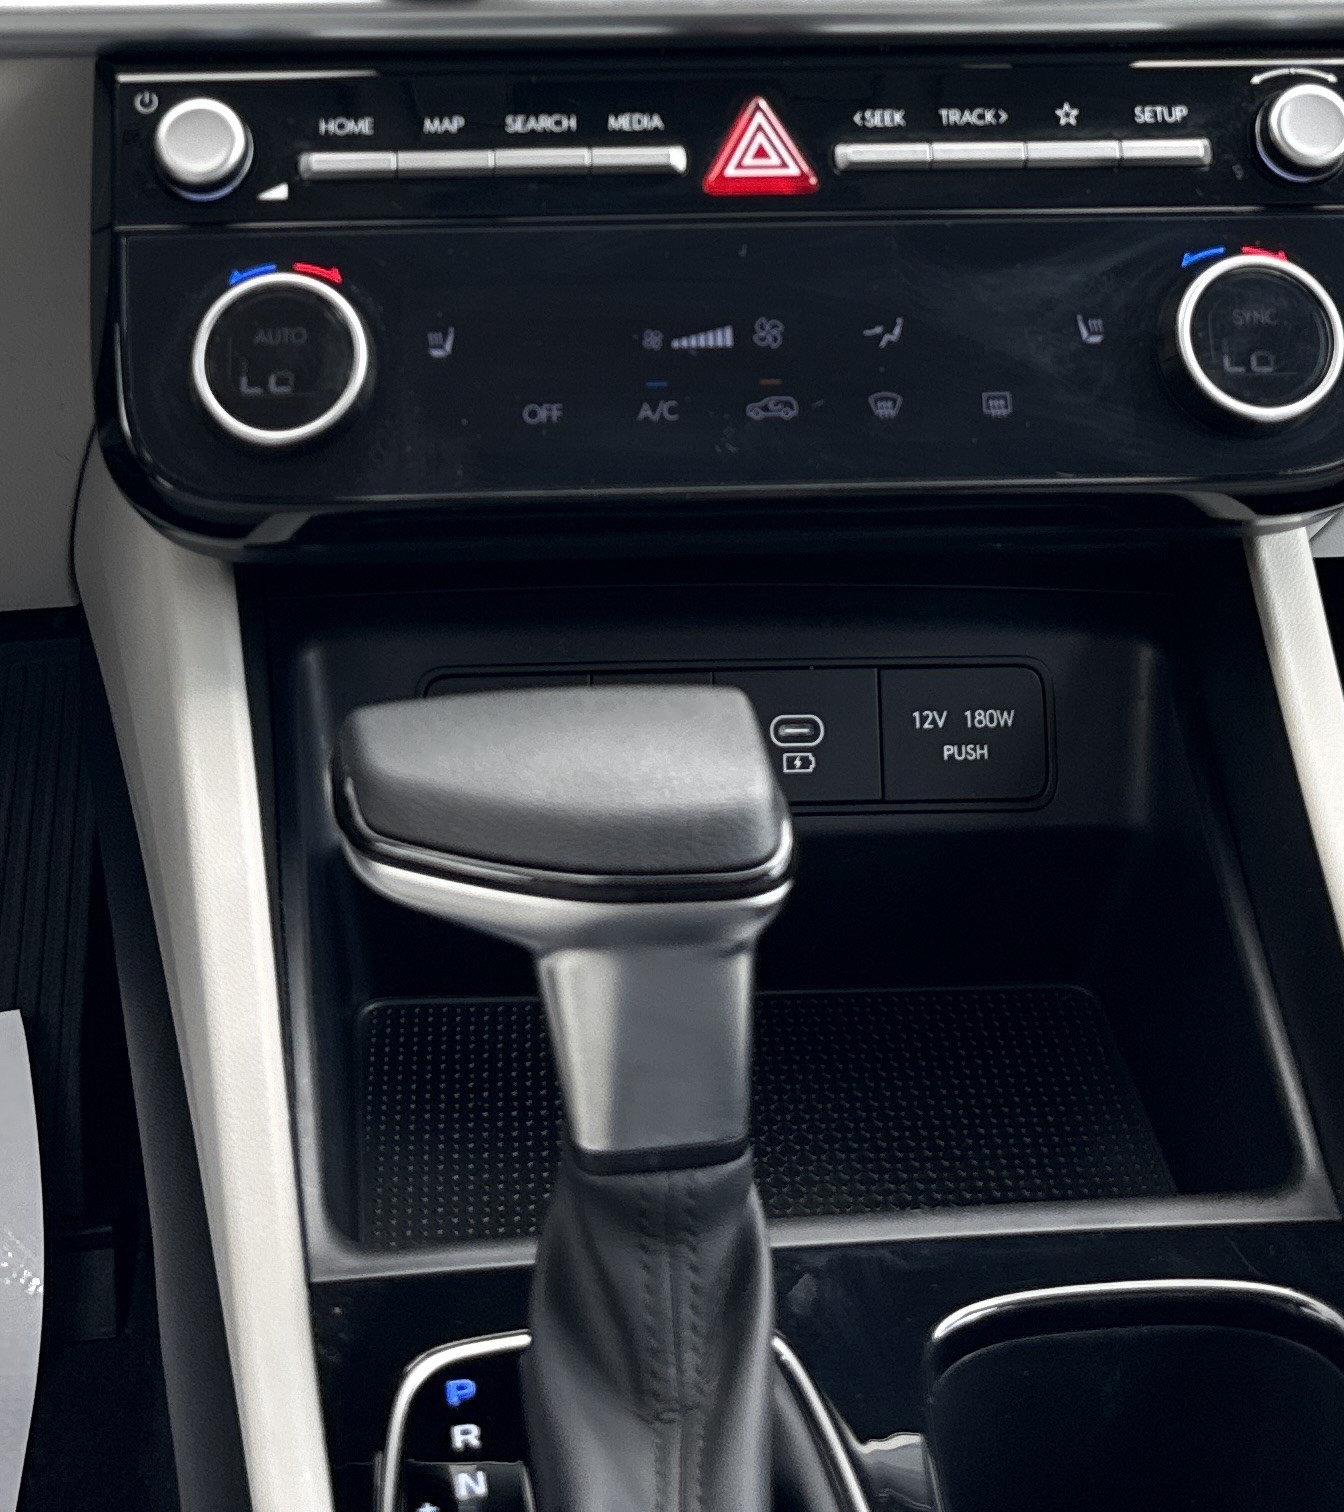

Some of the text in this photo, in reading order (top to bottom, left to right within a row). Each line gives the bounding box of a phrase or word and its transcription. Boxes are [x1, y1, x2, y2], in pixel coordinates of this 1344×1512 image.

[319, 112, 664, 136] HOME MAP SEARCH MEDIA
[1133, 105, 1189, 124] SETUP
[1231, 308, 1279, 327] SYNC
[253, 326, 308, 345] AUTO
[522, 402, 679, 424] OFF A/C
[911, 709, 1016, 730] 12V 180W
[942, 744, 989, 761] PUSH
[444, 1378, 477, 1406] P
[450, 1423, 482, 1451] R
[456, 1471, 488, 1500] N
